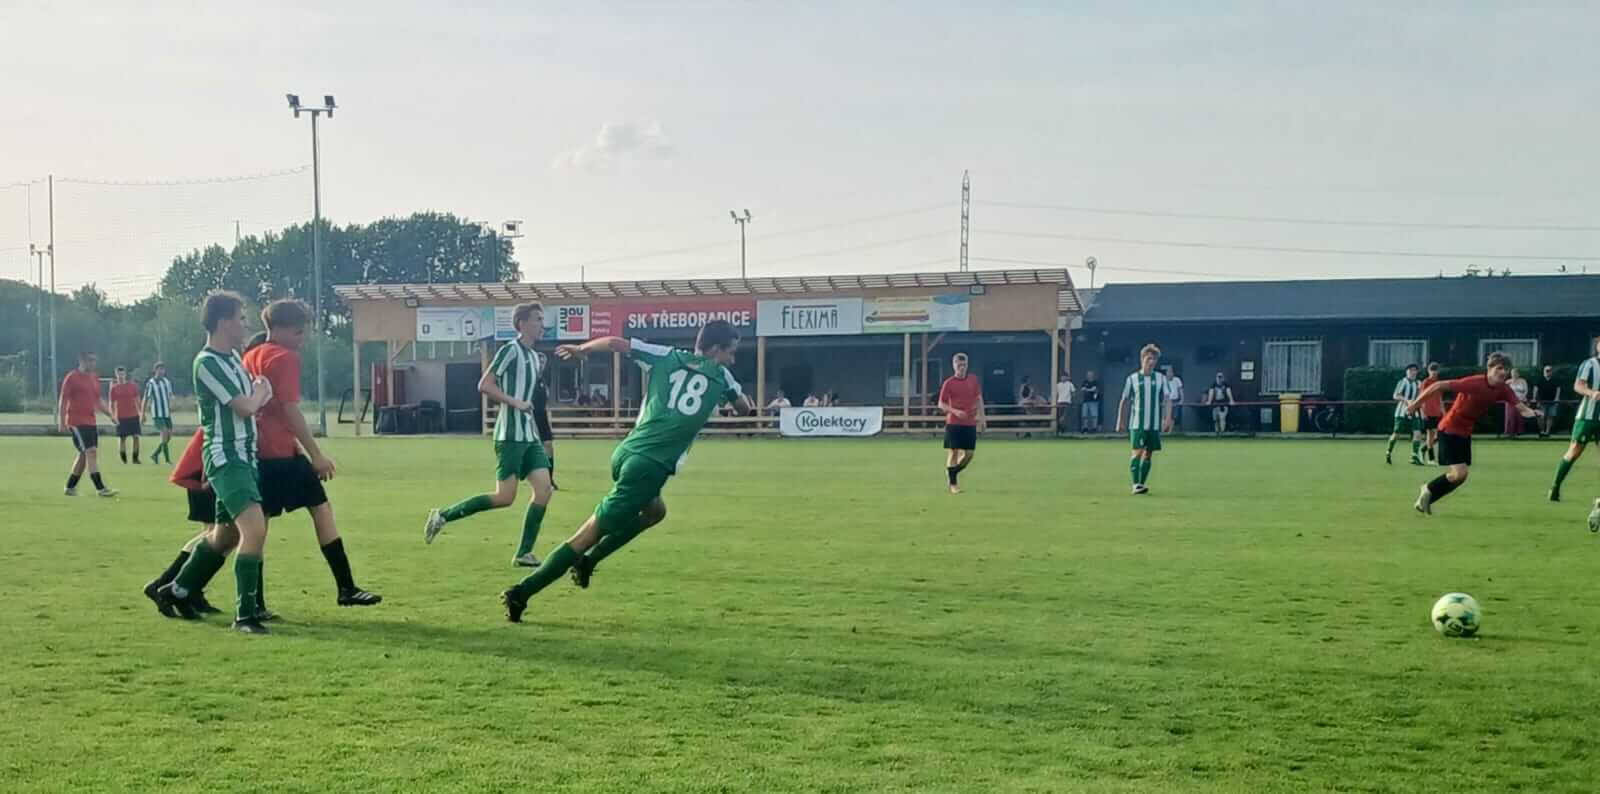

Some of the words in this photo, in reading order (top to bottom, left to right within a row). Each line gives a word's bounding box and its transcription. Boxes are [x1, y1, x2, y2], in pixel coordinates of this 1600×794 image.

[628, 313, 648, 329] SK
[781, 304, 838, 329] FLEXIMA
[667, 368, 709, 416] 18
[798, 412, 867, 433] Kolektory
